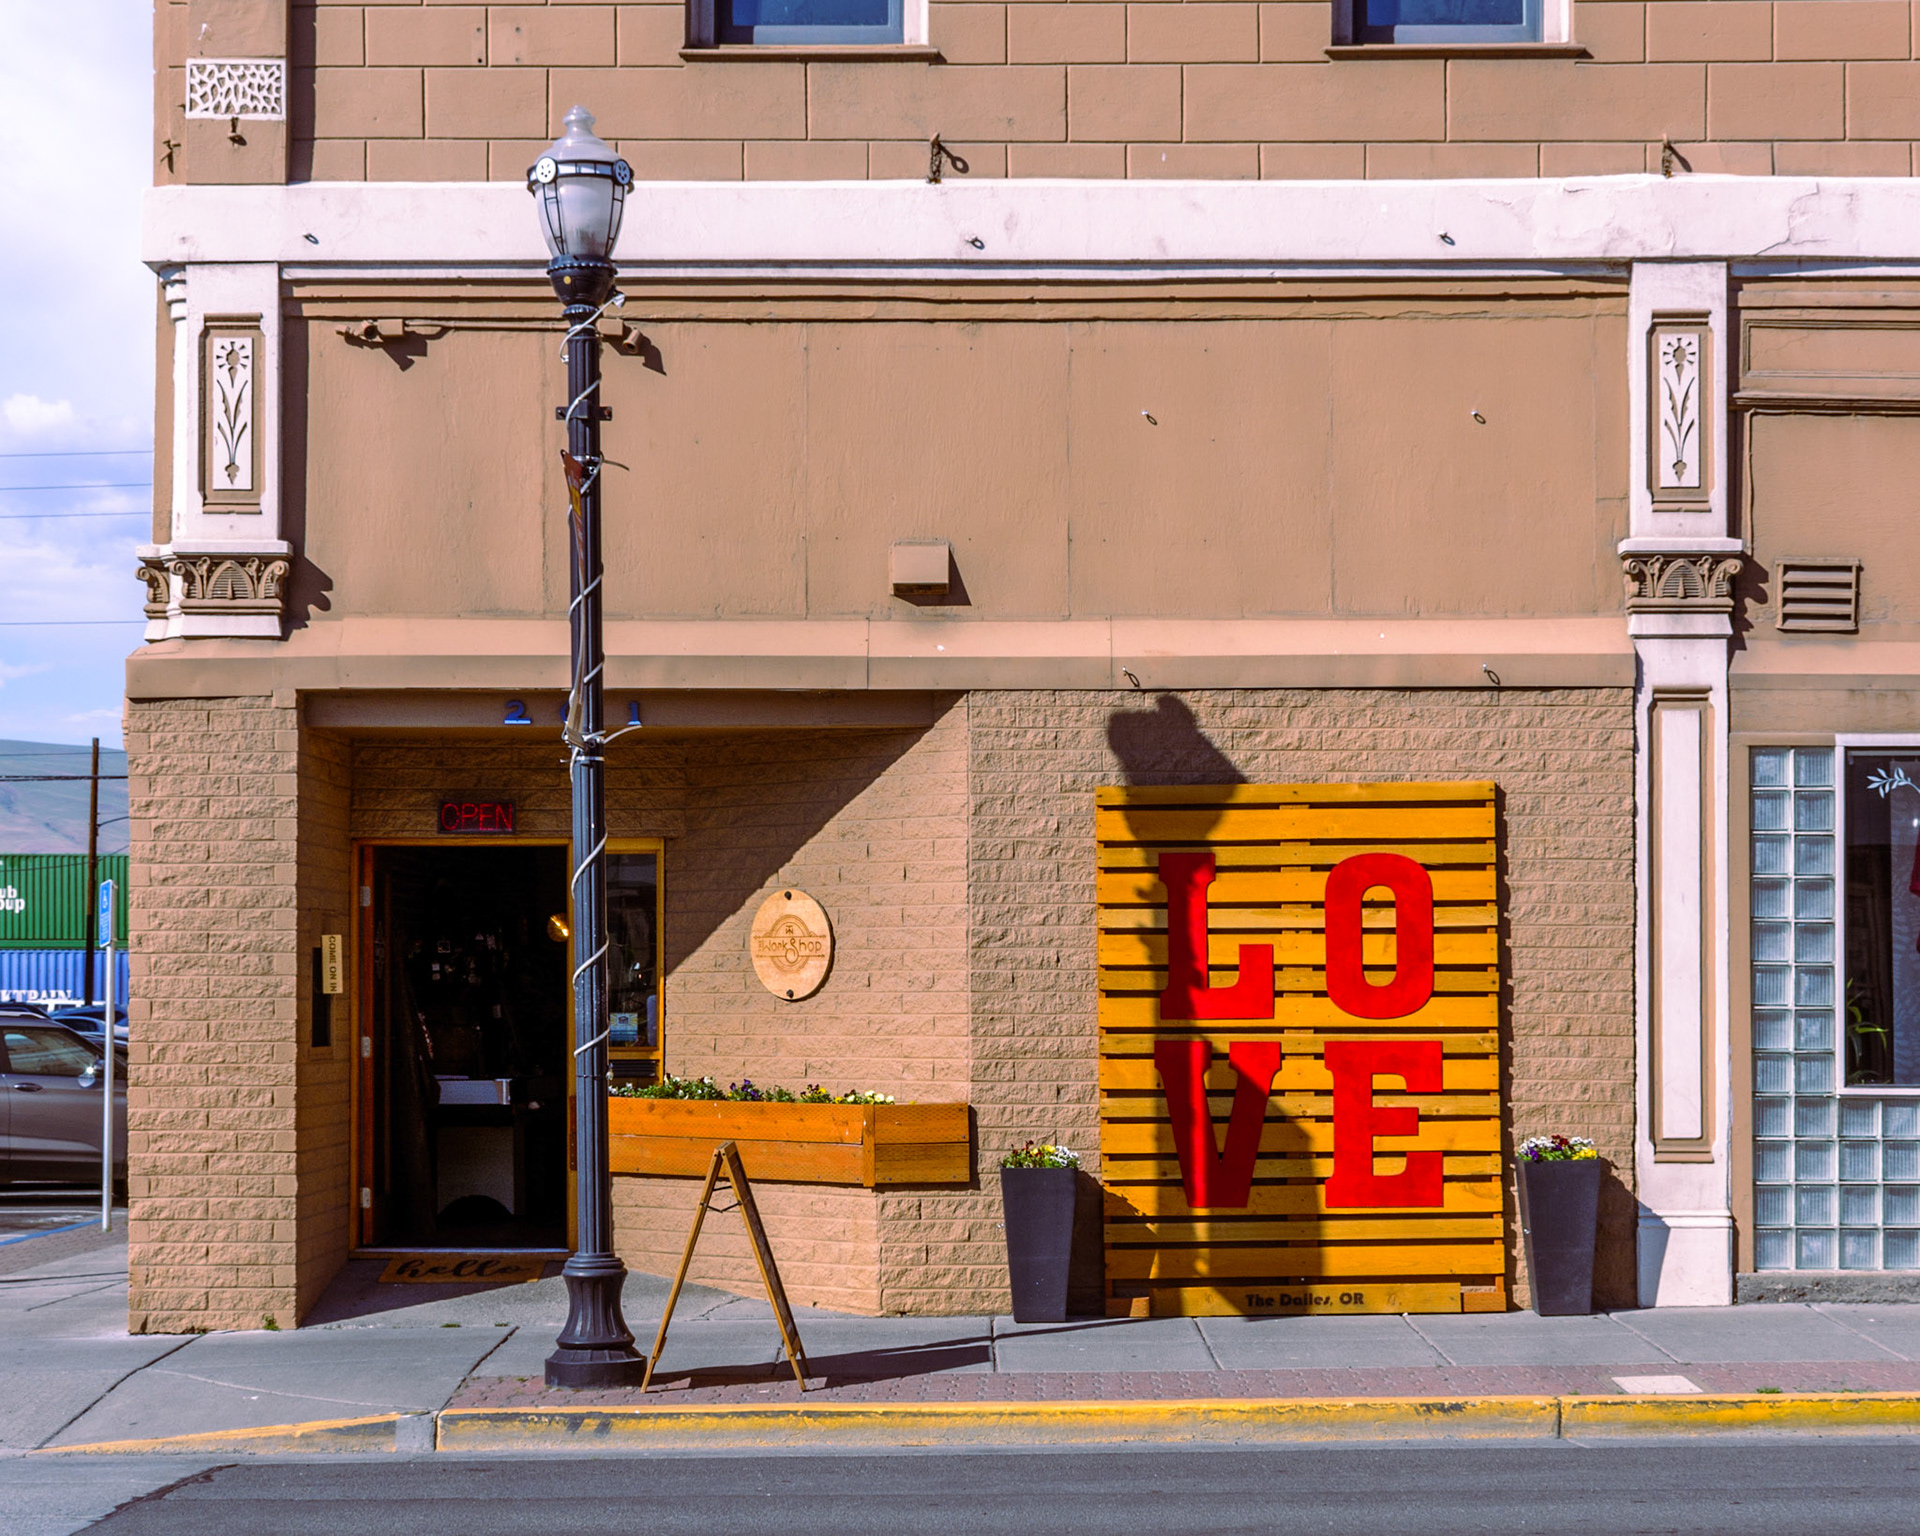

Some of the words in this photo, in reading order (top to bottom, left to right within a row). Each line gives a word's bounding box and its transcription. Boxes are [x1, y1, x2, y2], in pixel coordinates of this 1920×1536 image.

[504, 700, 641, 725] 21
[441, 803, 513, 831] OPEN
[329, 966, 337, 980] ON
[330, 982, 337, 992] IN
[396, 1259, 532, 1278] hello
[1245, 1294, 1275, 1307] The
[1280, 1293, 1333, 1307] Dalles,
[1339, 1293, 1364, 1305] OR
